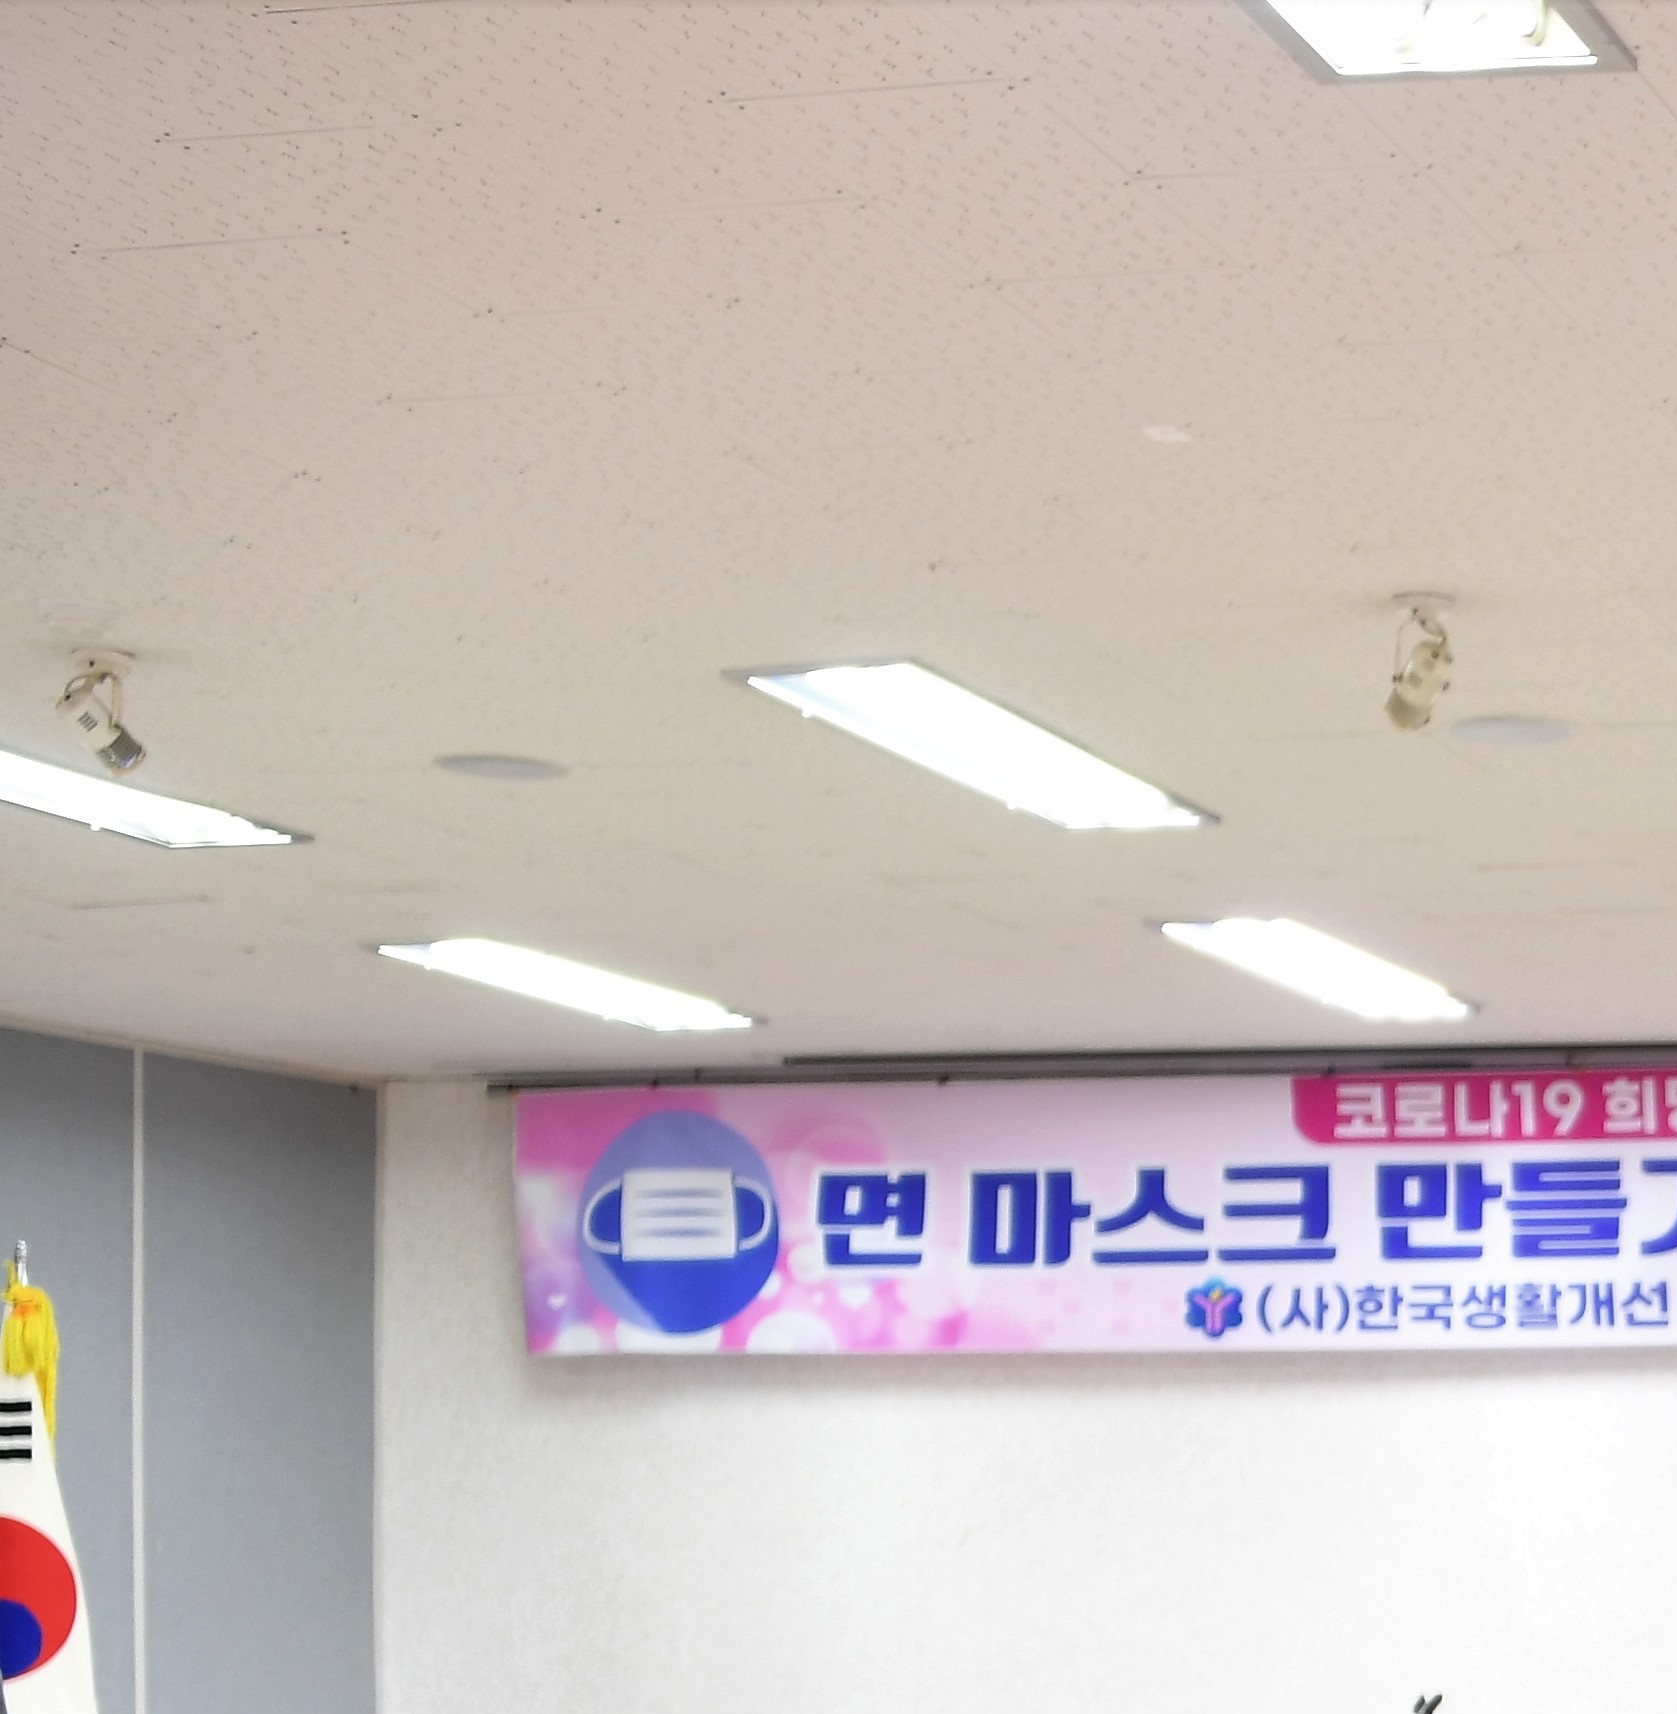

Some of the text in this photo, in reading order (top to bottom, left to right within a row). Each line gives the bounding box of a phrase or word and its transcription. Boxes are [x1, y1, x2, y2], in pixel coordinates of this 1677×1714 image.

[1333, 1078, 1585, 1139] 코로나19
[815, 1171, 927, 1267] 면
[969, 1163, 1337, 1267] 마스크
[1256, 1280, 1670, 1334] (사)한국생활개선
